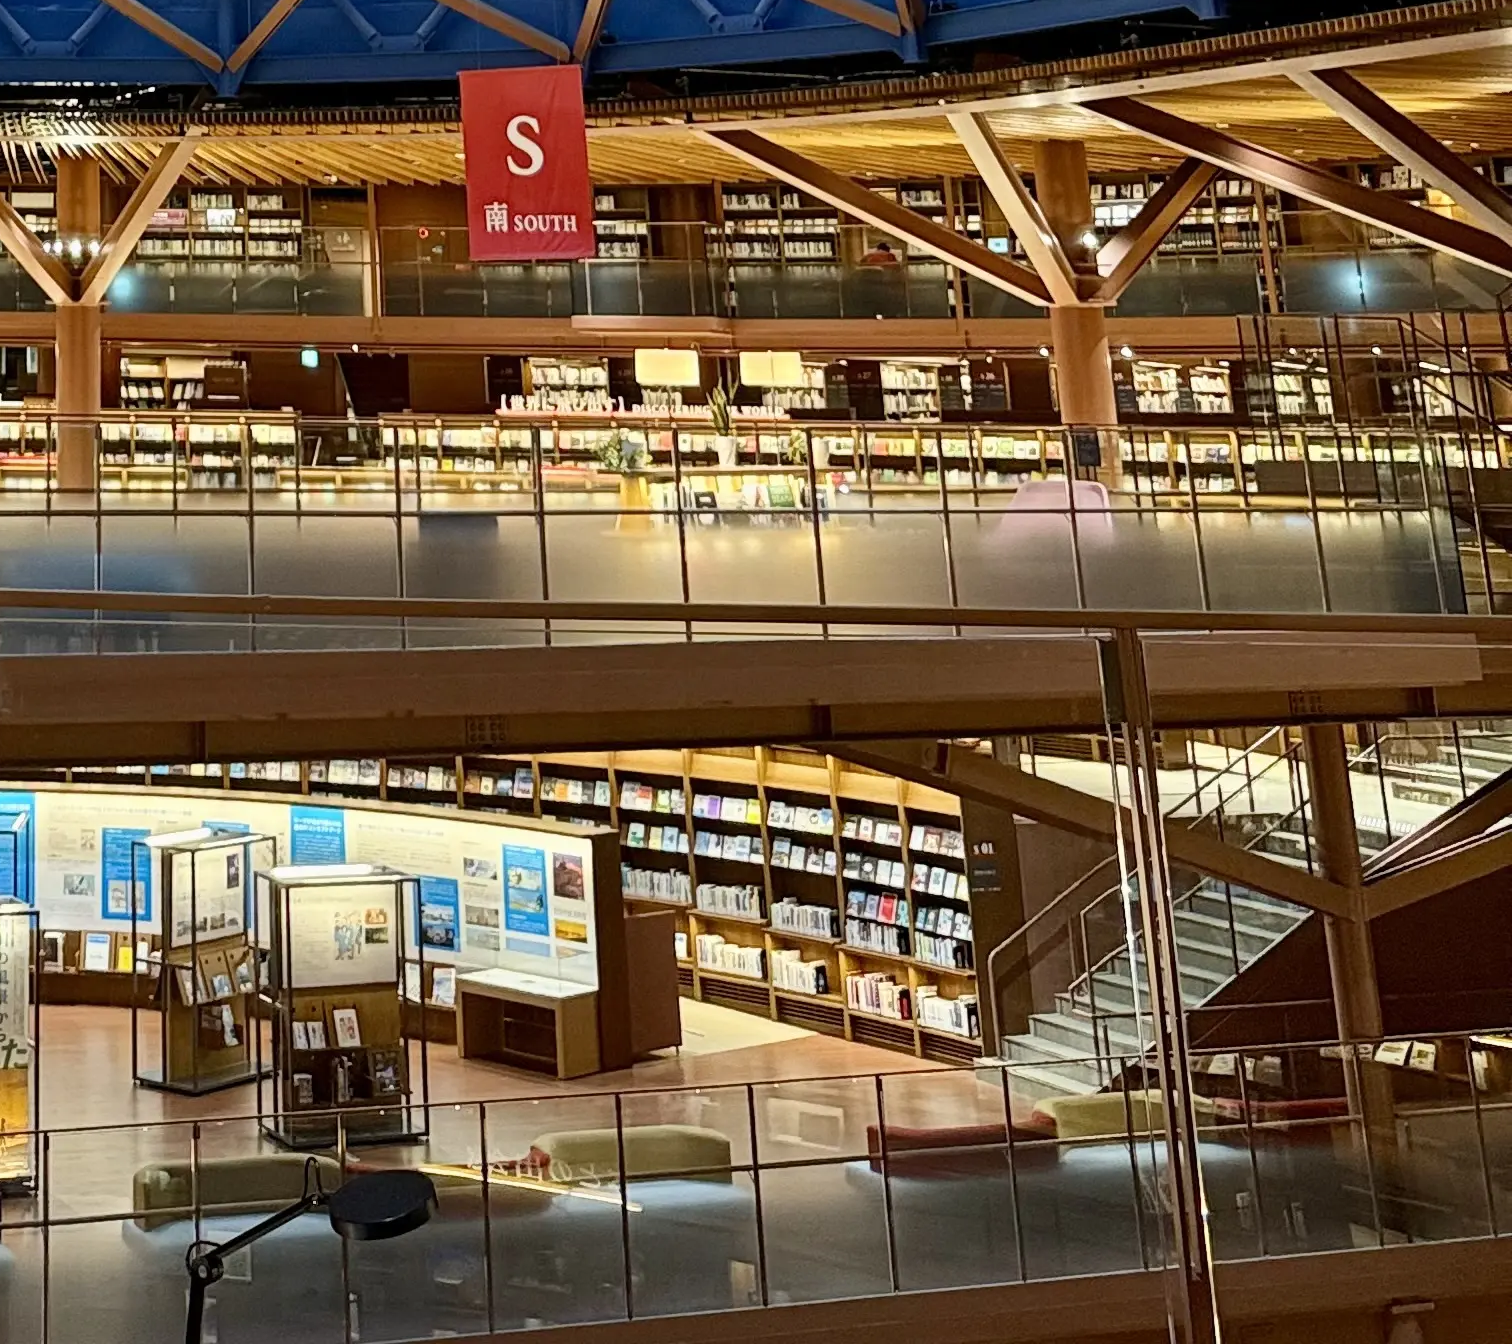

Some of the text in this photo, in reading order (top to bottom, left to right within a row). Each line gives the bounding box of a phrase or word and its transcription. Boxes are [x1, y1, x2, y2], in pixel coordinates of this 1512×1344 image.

[506, 115, 545, 177] S
[483, 201, 578, 233] 南 SOUTH
